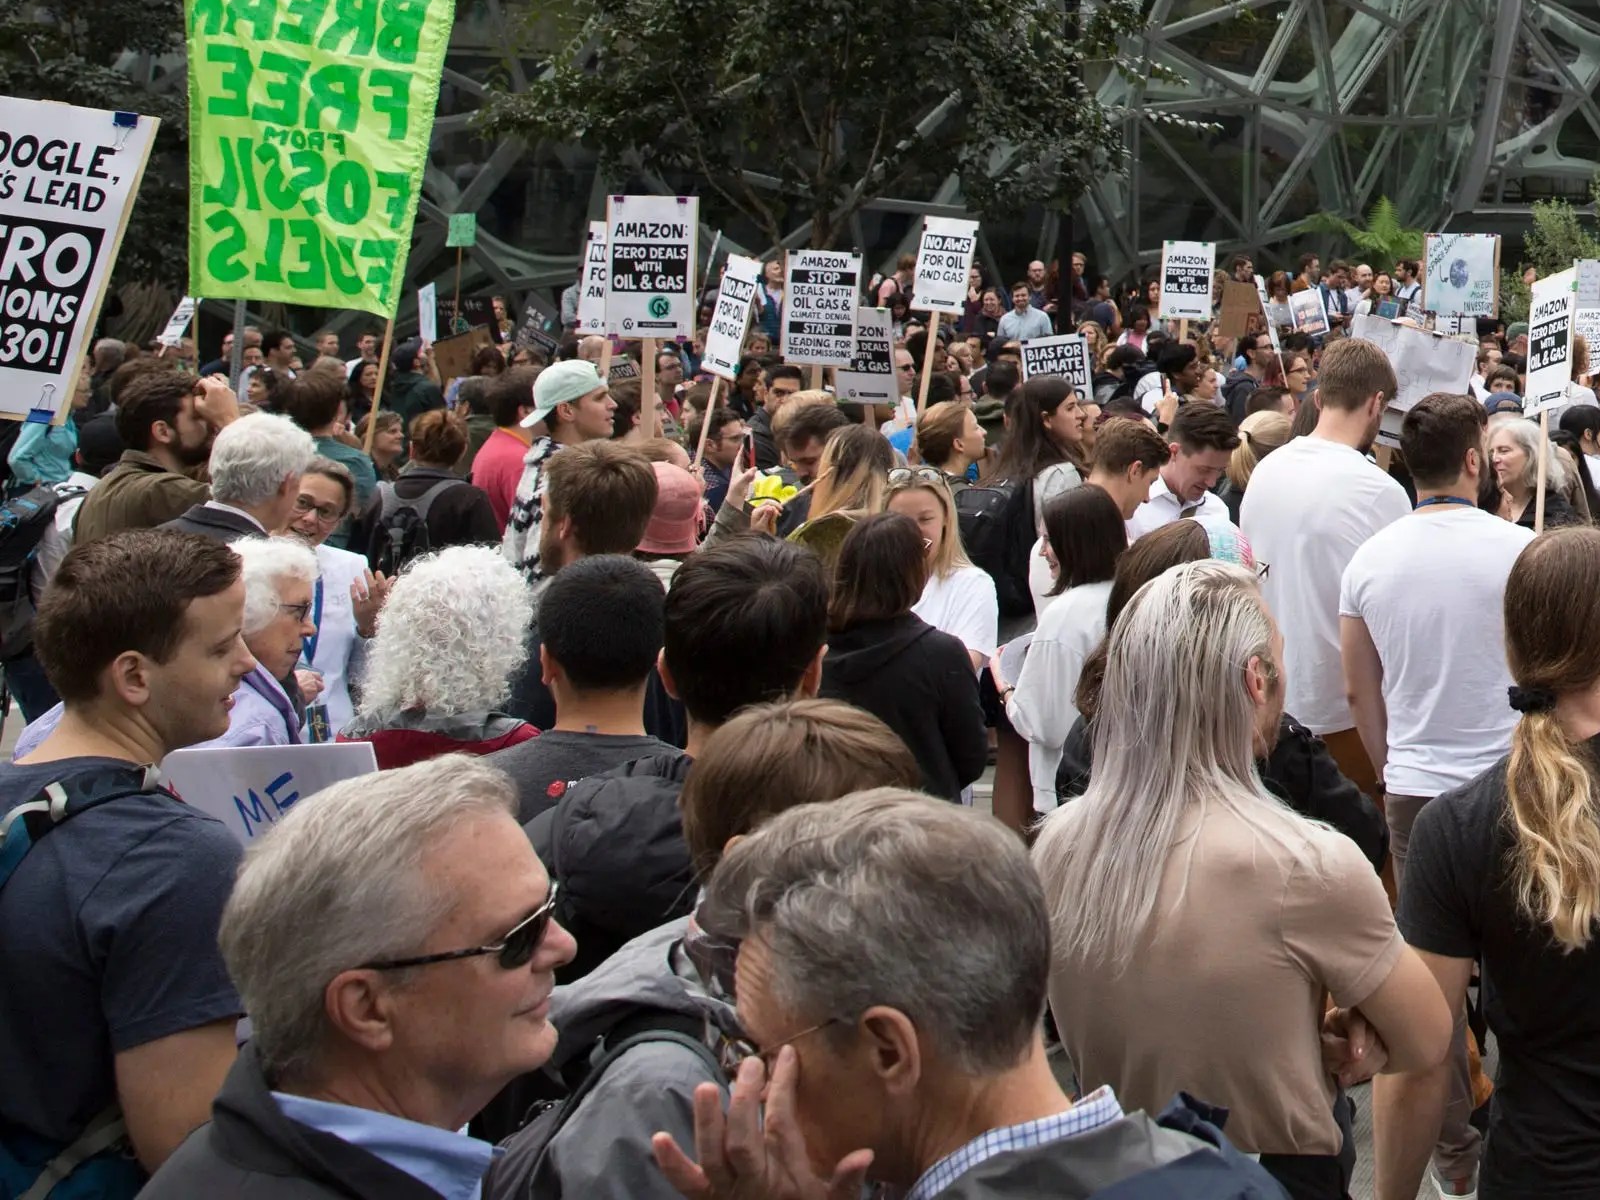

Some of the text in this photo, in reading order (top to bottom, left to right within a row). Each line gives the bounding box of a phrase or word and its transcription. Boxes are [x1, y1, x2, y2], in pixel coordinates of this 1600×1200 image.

[24, 176, 106, 213] LEAD
[615, 222, 688, 238] AMAZON:
[925, 236, 970, 252] NO AWS
[0, 225, 91, 288] RO
[614, 246, 687, 260] ZERO DEALS
[634, 261, 662, 272] WITH
[923, 254, 965, 269] FOR OIL
[808, 272, 840, 284] STOP
[919, 269, 964, 283] AND GAS
[1167, 268, 1185, 276] ZERO
[614, 274, 684, 290] OIL & GAS
[723, 278, 735, 295] NO
[1166, 283, 1207, 293] OIL & GAS
[793, 285, 852, 297] DEALS WITH
[0, 285, 78, 324] IONS
[719, 300, 744, 322] FOR OIL
[816, 299, 838, 310] GAS
[842, 300, 851, 311] &
[791, 311, 851, 321] CLIMATE DENIAL
[713, 320, 741, 339] AND GAS
[803, 324, 838, 334] START
[1532, 318, 1568, 340] ZERO DEALS
[0, 323, 64, 366] 30!
[789, 337, 851, 348] LEADING FOR
[861, 343, 888, 351] DEALS
[1540, 337, 1555, 350] WITH
[788, 347, 851, 358] ZERO EMISSIONS
[1027, 344, 1081, 361] BIAS FOR
[1530, 345, 1566, 369] OIL & GAS
[868, 362, 890, 371] GAS
[1028, 357, 1083, 374] CLIMATE
